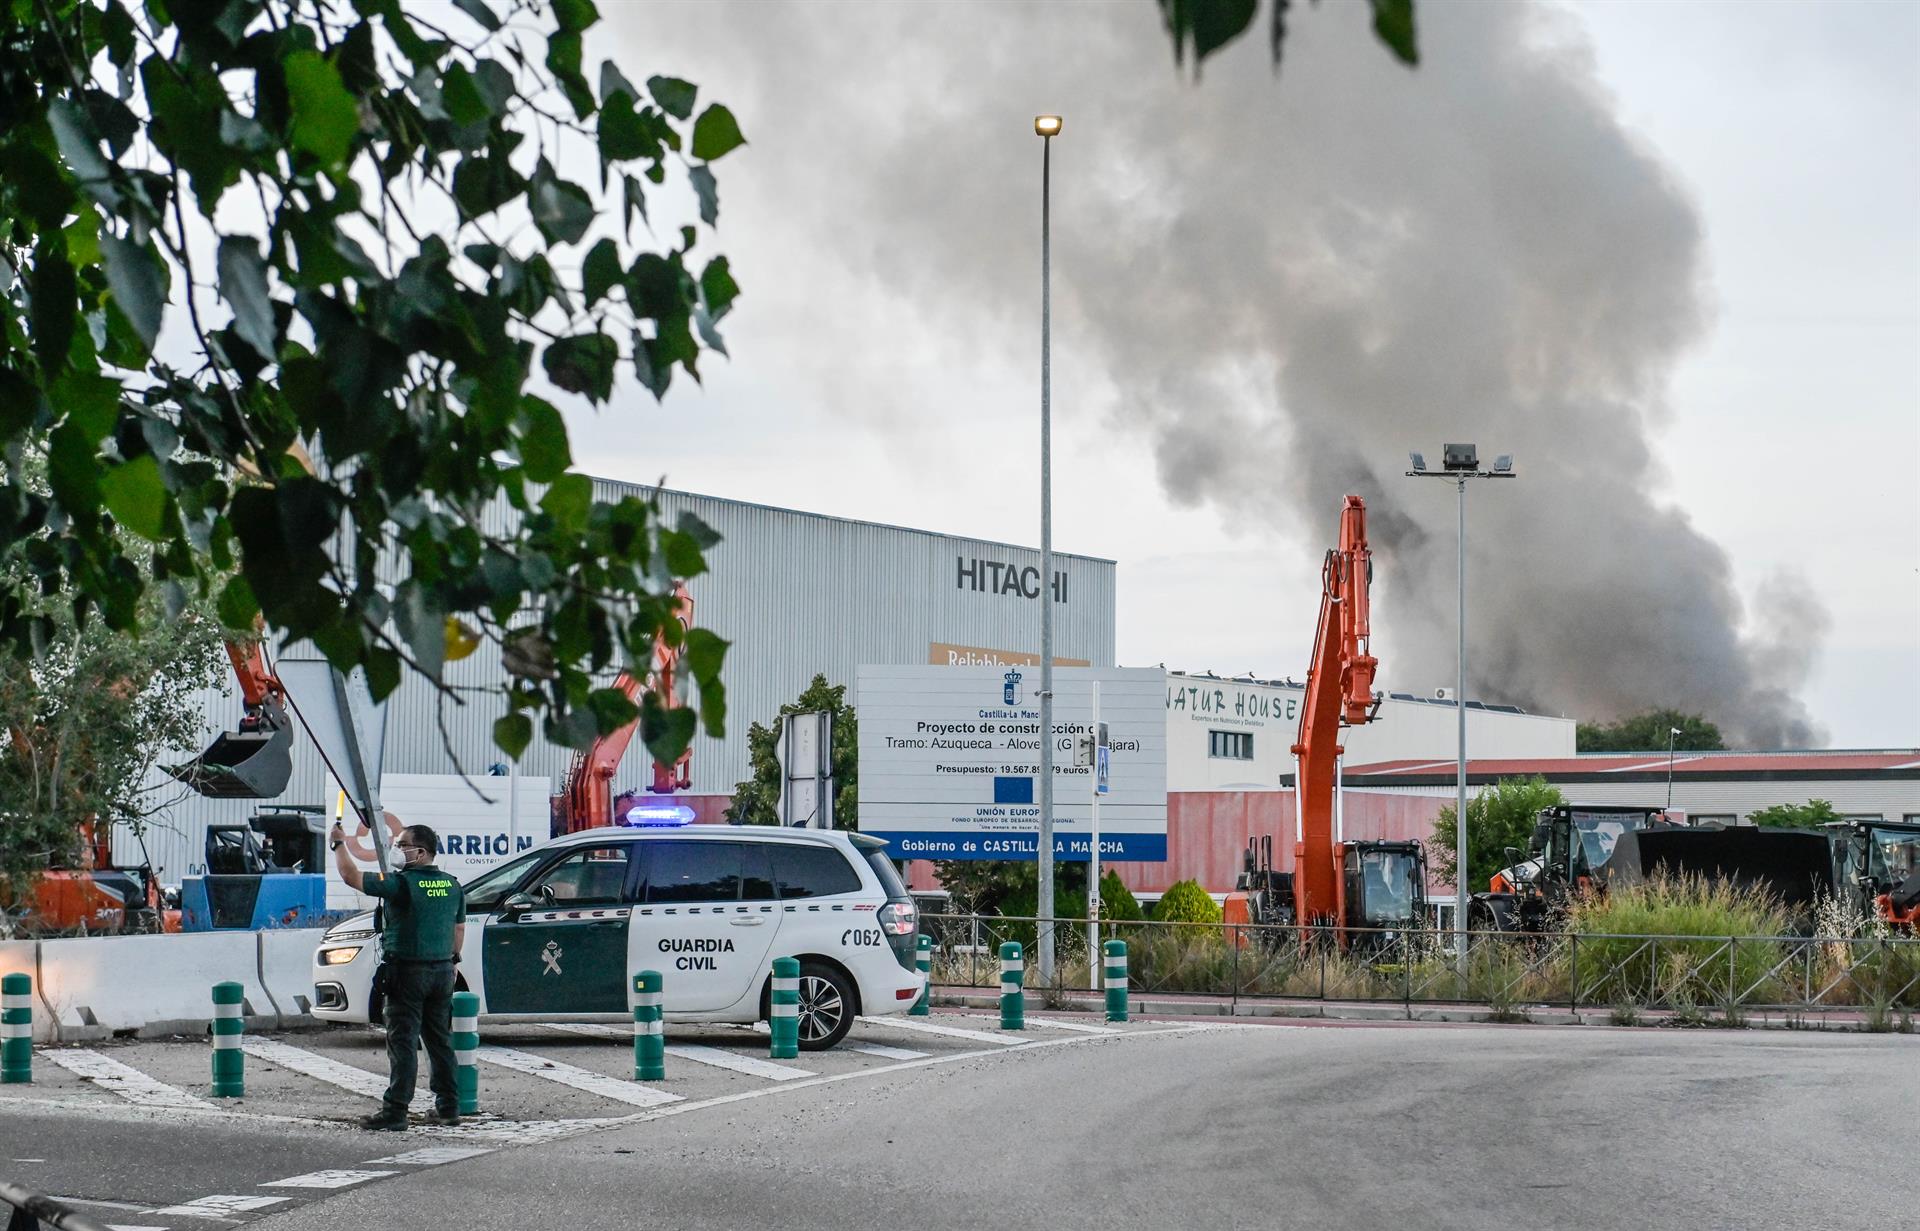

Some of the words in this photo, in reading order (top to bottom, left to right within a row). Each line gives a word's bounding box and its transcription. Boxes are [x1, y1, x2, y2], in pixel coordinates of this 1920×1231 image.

[1235, 691, 1296, 720] HOUSE
[1021, 710, 1040, 719] Manc
[917, 721, 976, 735] Proyecto
[980, 722, 995, 734] de
[999, 723, 1084, 734] constrcción
[885, 737, 928, 748] Tramo:
[931, 737, 992, 751] Azuqueca
[1007, 738, 1041, 750] Alove
[936, 764, 997, 775] Presupuesto:
[976, 807, 1005, 816] UNIÓN
[1010, 808, 1040, 816] EUROP
[435, 833, 532, 855] ARRIÓN
[902, 839, 956, 851] Gobierno
[962, 841, 977, 852] de
[418, 879, 453, 888] GUARDIA
[427, 889, 448, 897] CIVIL
[853, 929, 881, 947] 062
[658, 938, 735, 952] GUARDIA
[675, 957, 717, 970] CIVIL
